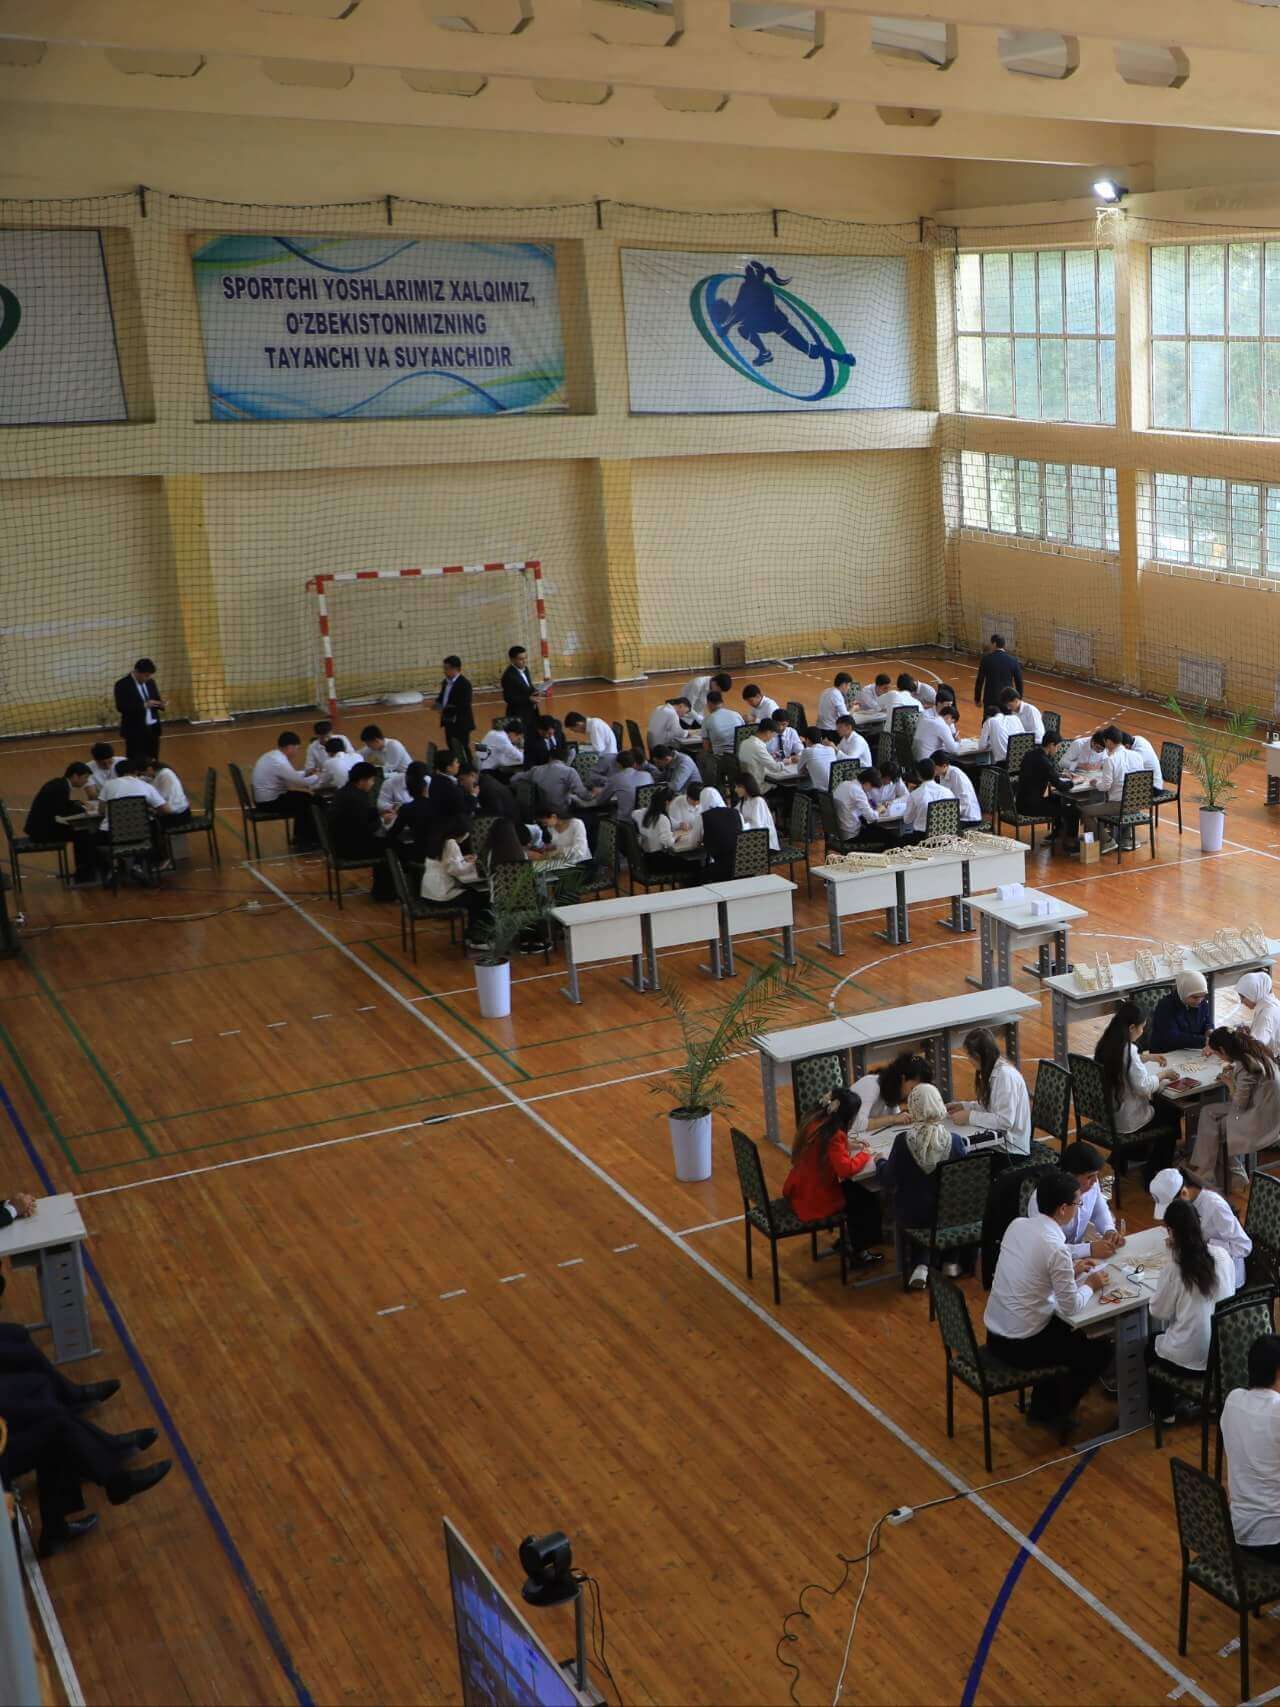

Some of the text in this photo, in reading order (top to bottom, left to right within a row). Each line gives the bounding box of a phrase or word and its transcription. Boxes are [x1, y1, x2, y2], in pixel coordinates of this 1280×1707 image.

[223, 277, 536, 306] SPORTCHI YOSHLARIMIZ XALQIMIZ,
[265, 346, 512, 368] TAYANCHI VA SUYANCHIDIR
